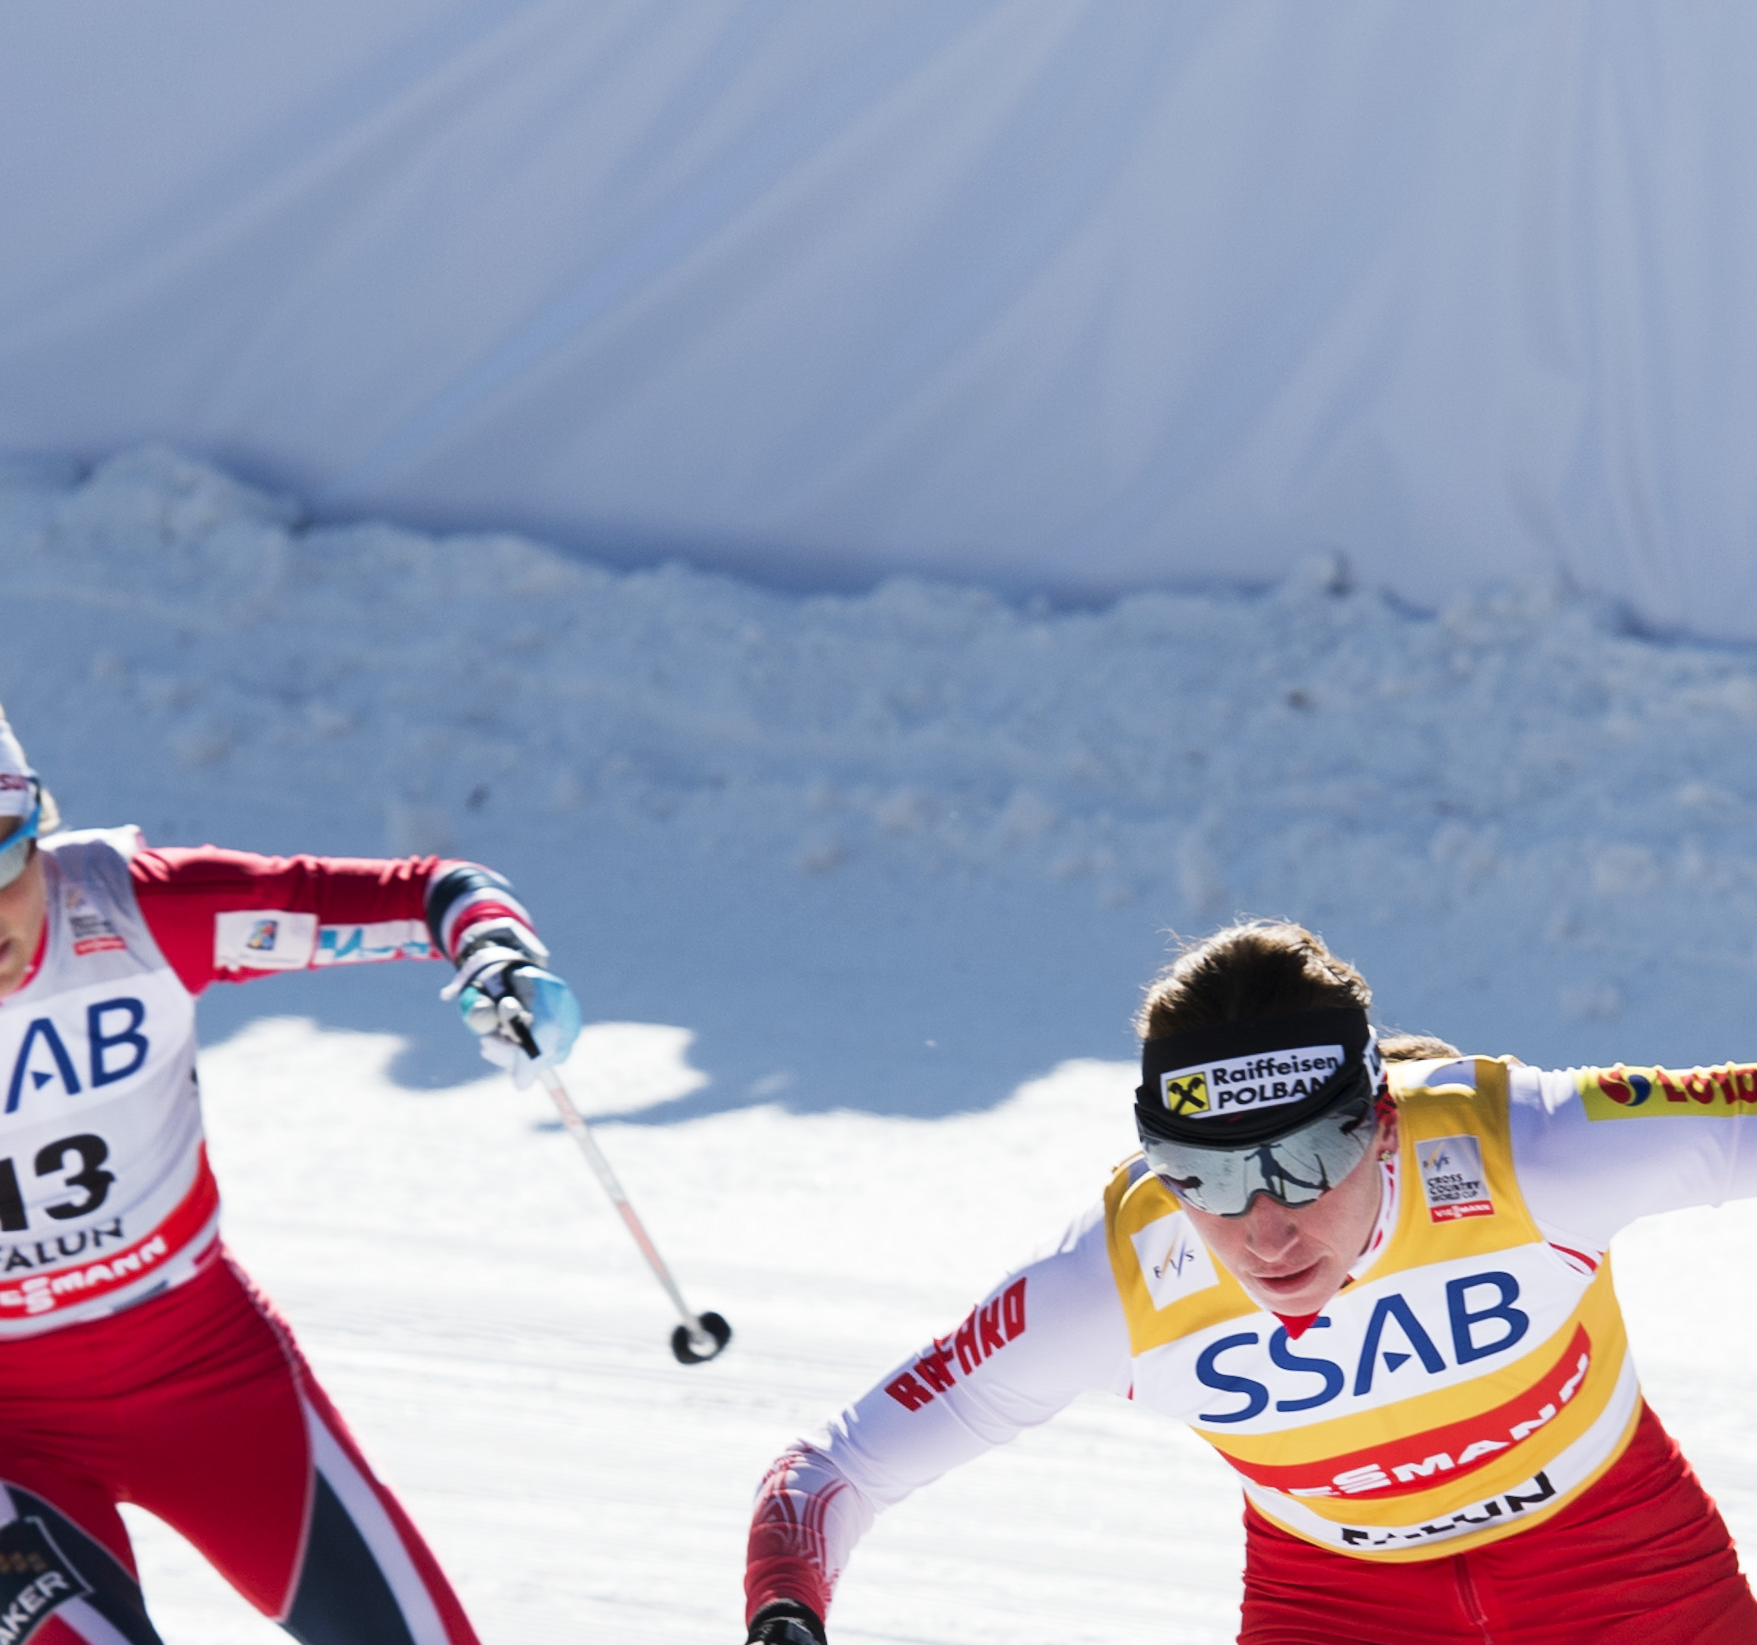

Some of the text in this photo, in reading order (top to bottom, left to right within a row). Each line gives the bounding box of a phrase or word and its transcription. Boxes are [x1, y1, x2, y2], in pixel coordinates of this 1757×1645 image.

[1212, 1055, 1339, 1086] Raiffeisen
[1217, 1075, 1333, 1110] POLBAN
[1427, 1173, 1463, 1187] CROSS
[1196, 1271, 1530, 1423] SSAB
